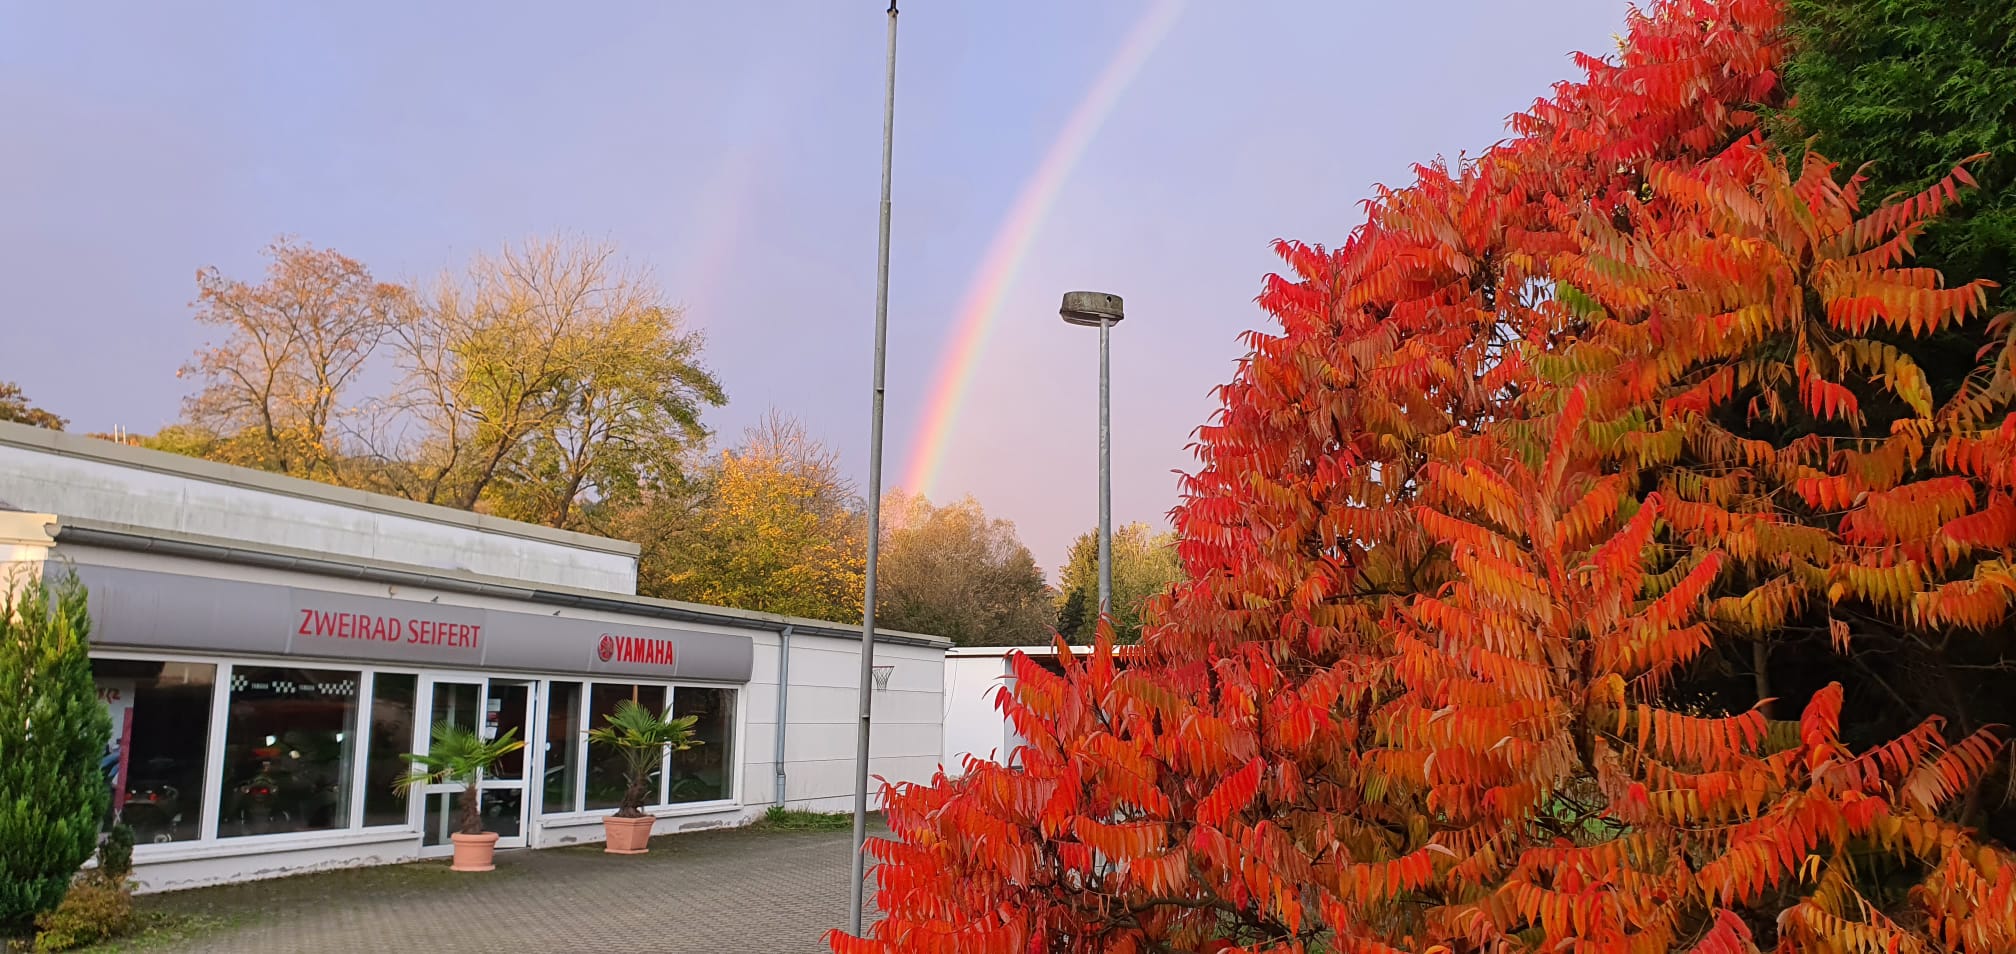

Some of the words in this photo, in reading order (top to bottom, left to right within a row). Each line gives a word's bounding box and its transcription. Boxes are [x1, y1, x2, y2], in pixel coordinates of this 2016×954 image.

[298, 609, 401, 642] ZWEIRAD
[407, 619, 480, 648] SEIFERT
[615, 635, 673, 665] YAMAHA
